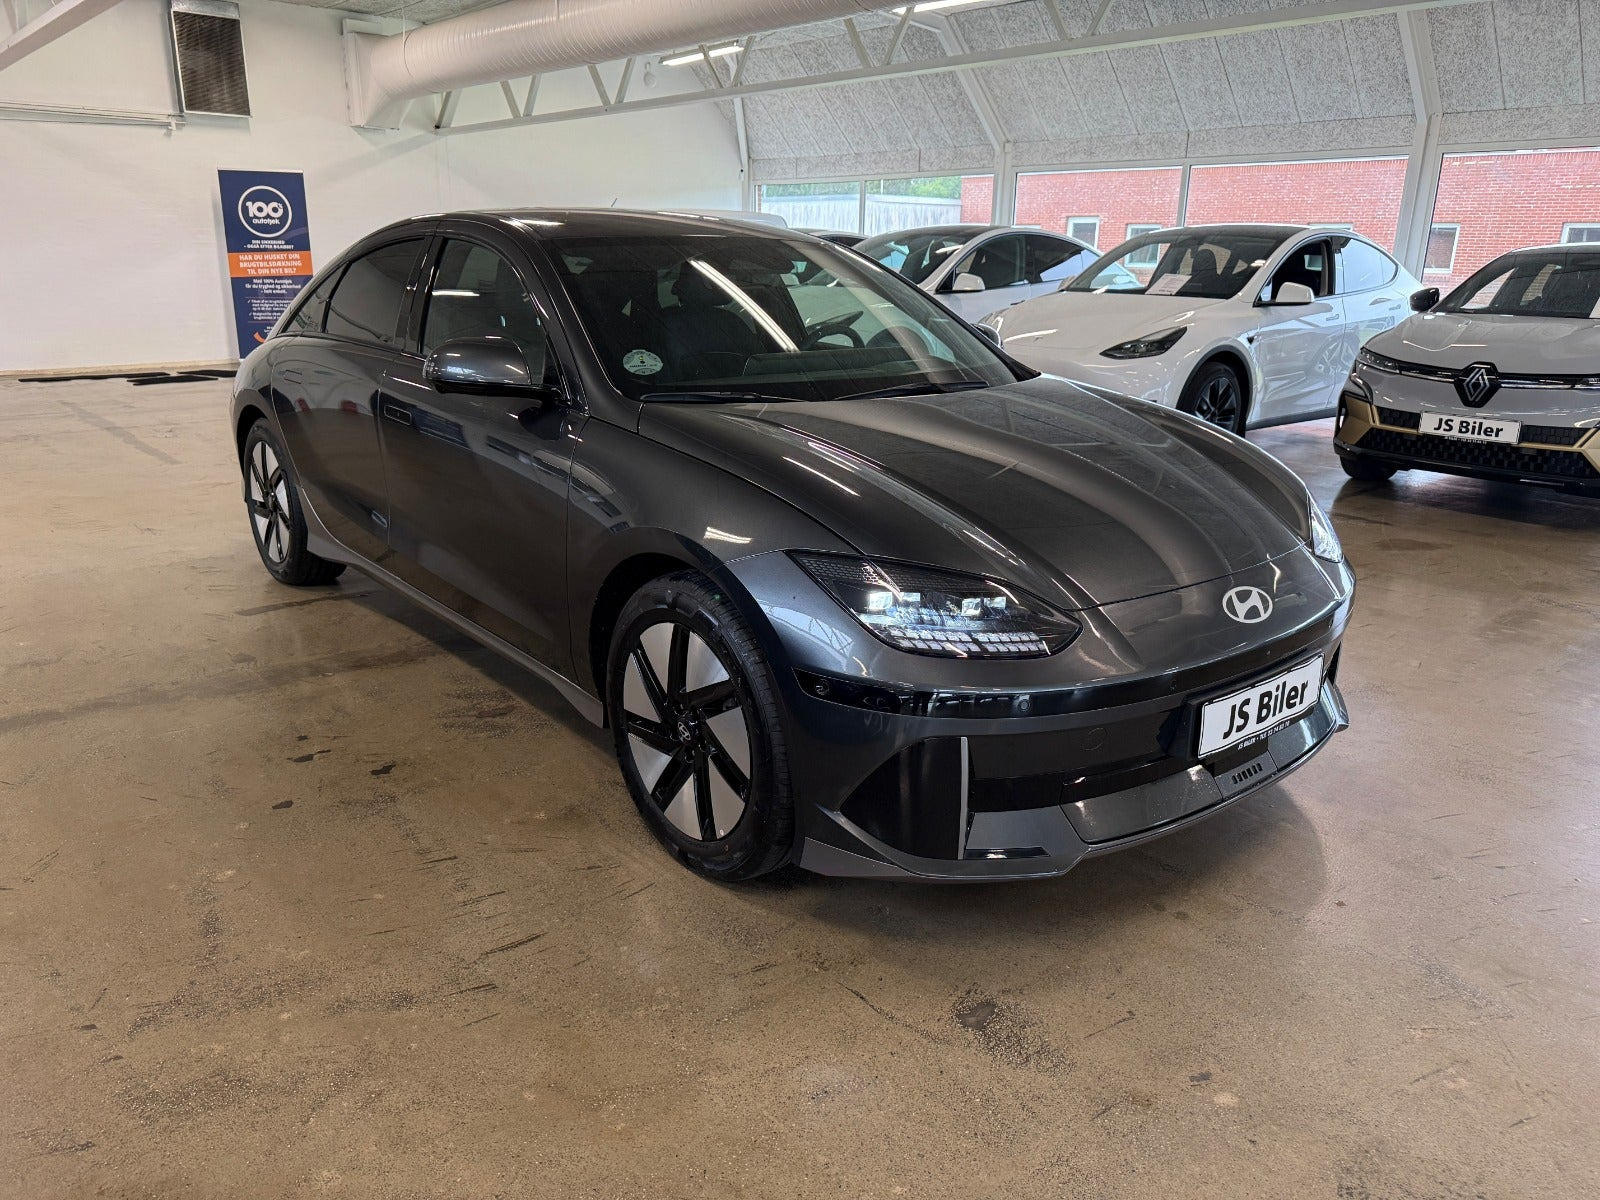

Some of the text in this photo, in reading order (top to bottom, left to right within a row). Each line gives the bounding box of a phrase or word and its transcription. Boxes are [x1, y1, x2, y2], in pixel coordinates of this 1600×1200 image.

[239, 260, 302, 268] BRUGTBILSDÆKNING
[1433, 417, 1504, 438] JS Biler
[1222, 680, 1309, 740] JS Biler
